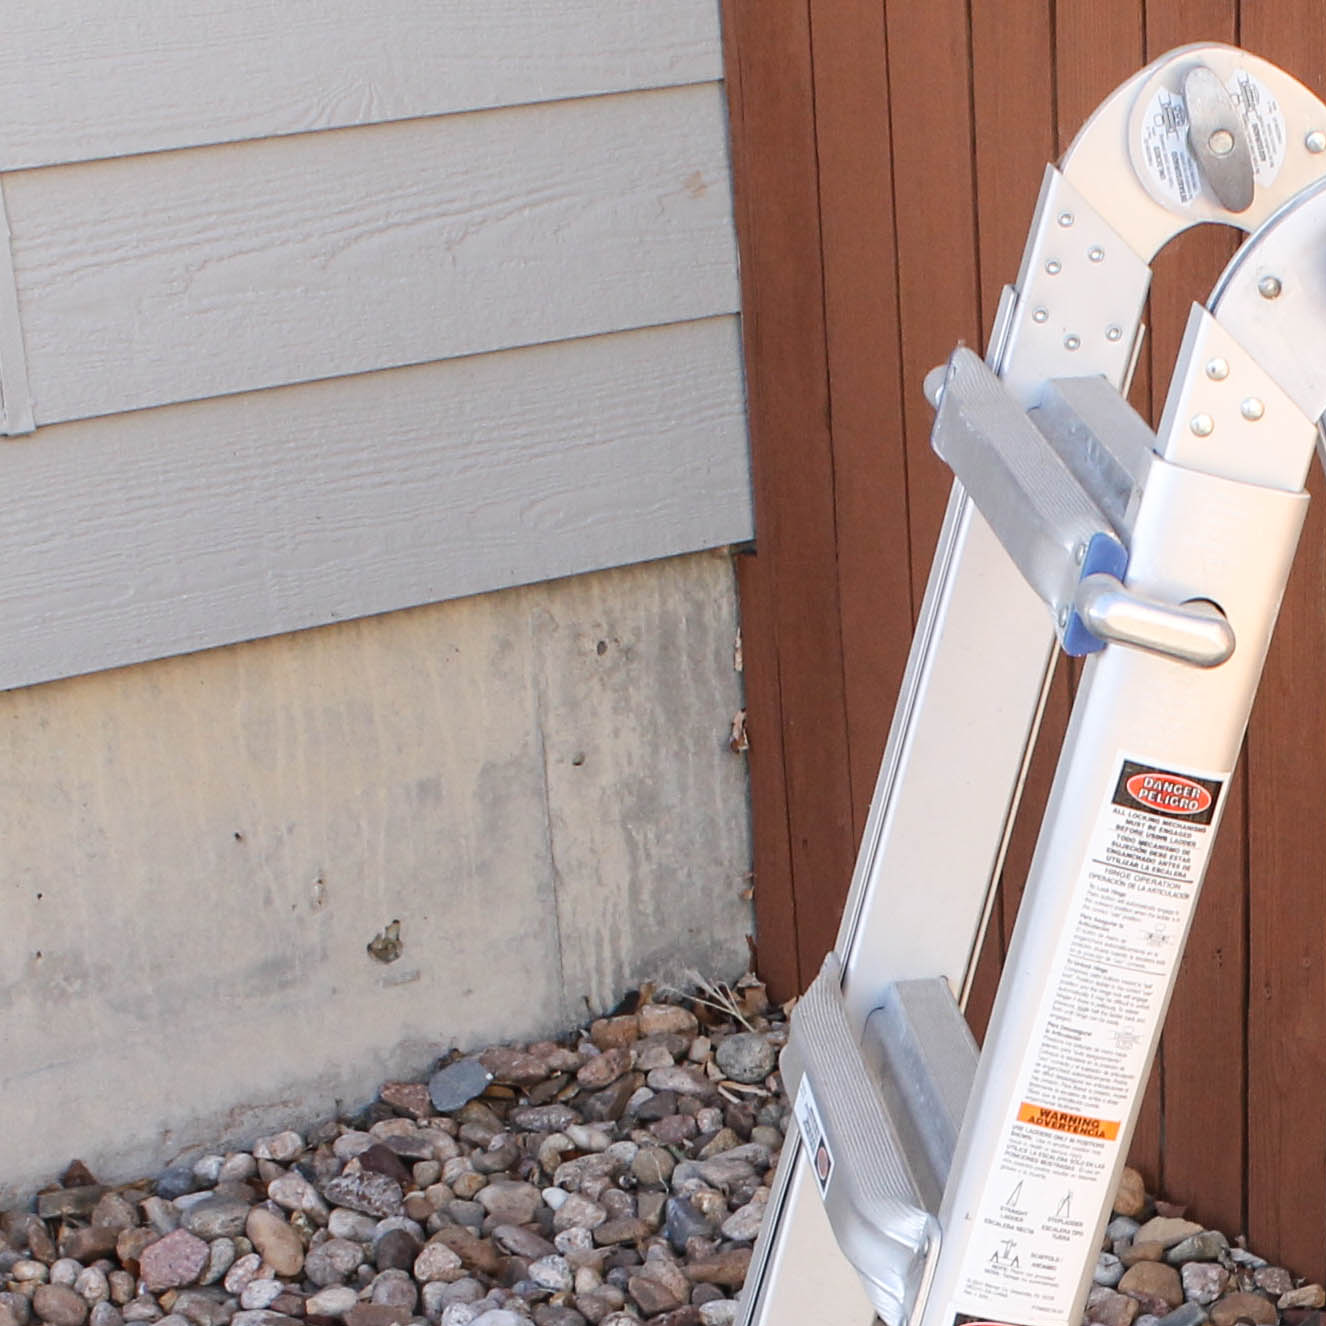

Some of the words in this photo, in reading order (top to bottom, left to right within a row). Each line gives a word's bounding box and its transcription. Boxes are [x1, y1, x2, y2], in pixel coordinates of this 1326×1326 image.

[1143, 777, 1201, 798] DANGER
[1138, 789, 1199, 810] PELIGRO
[1125, 819, 1144, 827] MUST
[1159, 827, 1192, 838] ENGAGED
[1128, 812, 1159, 822] LOCKING
[1163, 820, 1206, 832] MECHANISMS
[1115, 825, 1143, 834] BEFORE
[1146, 832, 1167, 840] USING
[1170, 837, 1195, 846] LADDER
[1116, 834, 1135, 842] TODO
[1138, 839, 1180, 852] MECANISMO
[1028, 1116, 1105, 1137] ADVERTENCIA
[1039, 1109, 1100, 1127] WARNING
